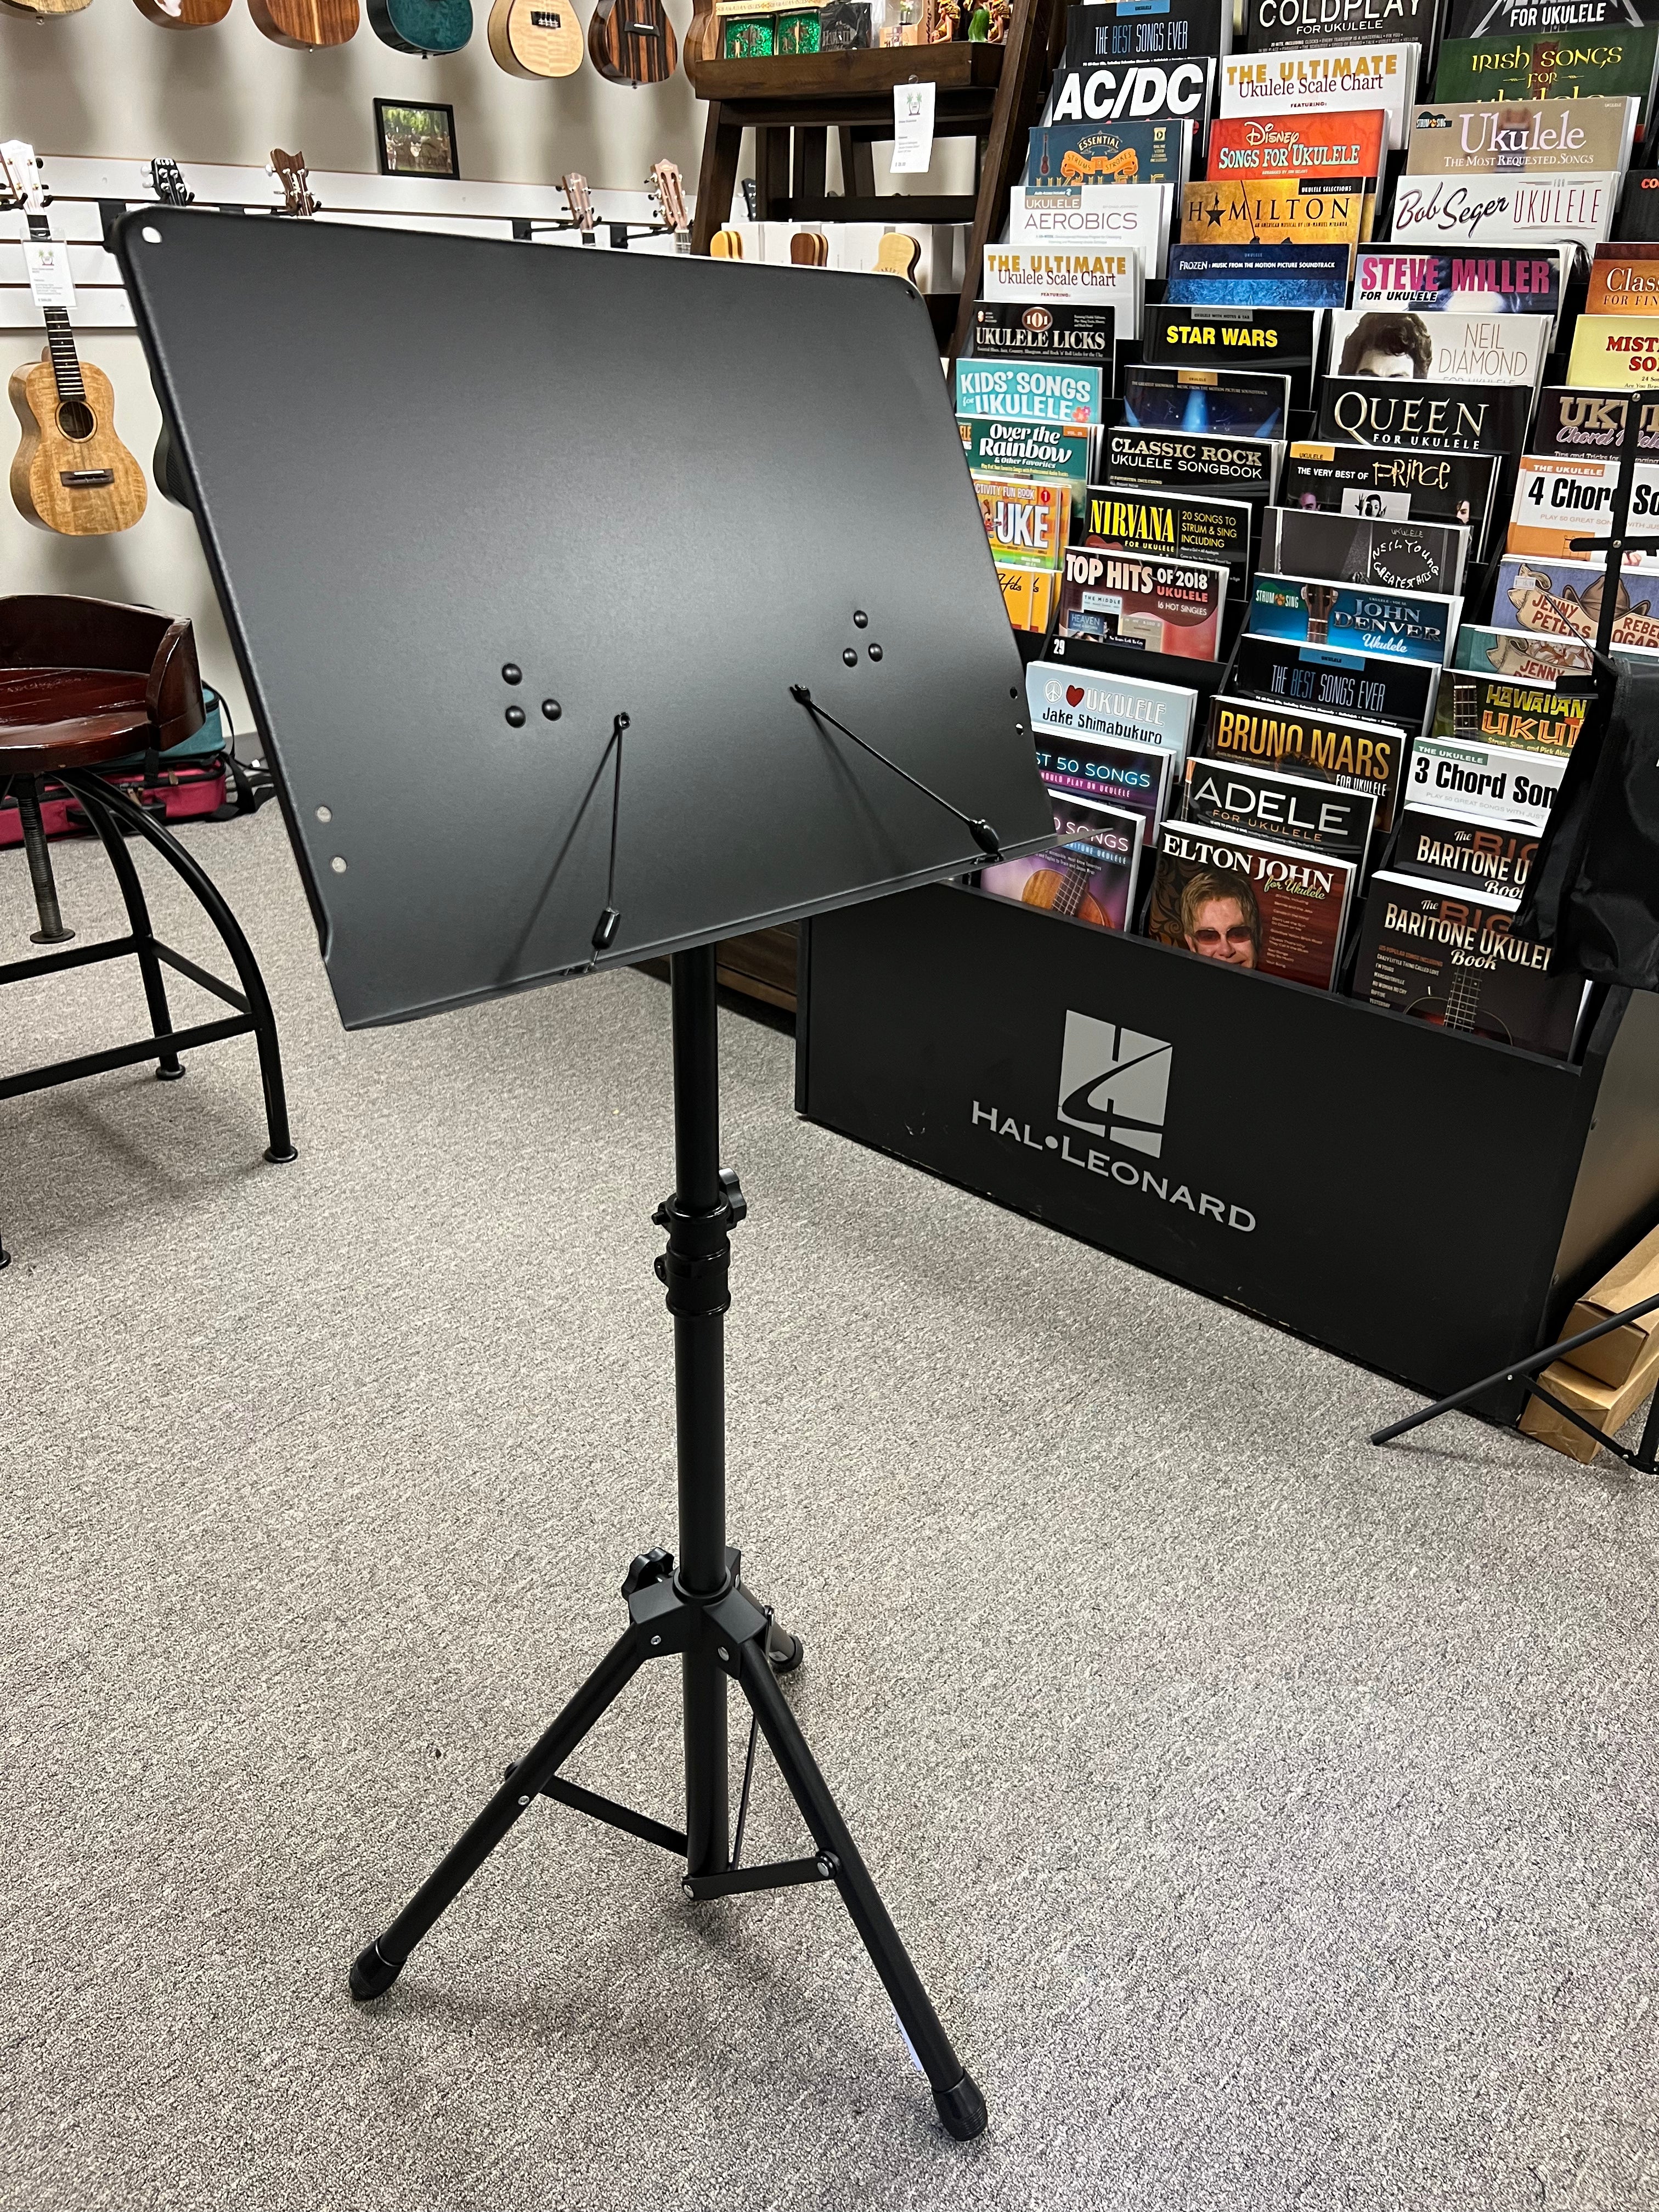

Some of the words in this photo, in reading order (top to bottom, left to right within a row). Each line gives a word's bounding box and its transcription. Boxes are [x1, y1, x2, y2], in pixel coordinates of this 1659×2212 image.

[1510, 8, 1537, 27] FOR
[1542, 2, 1606, 25] UKULELE
[1096, 26, 1108, 55] THE
[1113, 25, 1132, 54] BEST
[1136, 22, 1164, 52] SONGS
[1168, 21, 1188, 50] EVER
[1296, 25, 1321, 35] FOR
[1324, 20, 1383, 33] UKULELE
[1227, 65, 1267, 86] THE
[1279, 54, 1397, 80] ULTIMATE
[1052, 64, 1204, 121] AC/DC
[1238, 77, 1294, 98] Ukulele
[1298, 75, 1337, 94] Scale
[1341, 72, 1384, 91] Chart
[1079, 136, 1119, 151] ESSENTIAL
[1244, 121, 1300, 151] Disney
[1459, 110, 1587, 154] Ukulele
[1067, 154, 1091, 171] STRUMS
[1105, 152, 1132, 171] STROKES
[1218, 147, 1260, 169] SONGS
[1262, 148, 1289, 168] FOR
[1292, 144, 1361, 166] UKULELE
[1443, 156, 1464, 167] THE
[1466, 156, 1496, 167] MOST
[1497, 155, 1556, 167] REQUESTED
[1557, 153, 1594, 165] SONGS
[1026, 199, 1080, 209] UKULELE
[1396, 181, 1443, 230] Bob
[1438, 187, 1509, 239] Seger
[1514, 189, 1602, 223] UKULELE
[1024, 212, 1138, 230] AEROBICS
[988, 255, 1020, 272] THE
[1031, 256, 1126, 274] ULTIMATE
[1180, 261, 1207, 270] FROZEN
[1361, 257, 1439, 291] STEVE
[1452, 258, 1550, 294] MILLER
[998, 269, 1043, 284] Ukulele
[1046, 270, 1078, 286] Scale
[1081, 270, 1116, 286] Chart
[1359, 291, 1381, 301] FOR
[1386, 291, 1437, 302] UKULELE
[1604, 295, 1628, 305] FOR
[976, 327, 1048, 347] UKULELE
[1053, 330, 1105, 350] LICKS
[1166, 325, 1215, 345] STAR
[1222, 328, 1278, 348] WARS
[1464, 323, 1504, 349] NEIL
[1438, 349, 1527, 376] DIAMOND
[1016, 372, 1091, 402] SONGS
[975, 394, 1073, 421] UKULELE
[1334, 391, 1490, 445] QUEEN
[990, 424, 1030, 440] Over
[1033, 426, 1060, 444] the
[1373, 434, 1402, 444] FOR
[1411, 437, 1481, 450] UKULELE
[1556, 426, 1614, 445] Chord
[979, 438, 1072, 463] Rainbow
[1111, 437, 1196, 458] CLASSIC
[1201, 447, 1262, 466] ROCK
[1022, 459, 1056, 469] Favorites
[1111, 454, 1172, 470] UKULELE
[1178, 460, 1262, 479] SONGBOOK
[1297, 466, 1311, 475] THE
[1313, 467, 1333, 477] VERY
[1335, 470, 1356, 479] BEST
[1358, 472, 1369, 480] OF
[1534, 465, 1553, 473] THE
[1556, 466, 1603, 476] UKULELE
[1528, 476, 1545, 506] 4
[996, 501, 1049, 549] UKE
[1088, 499, 1175, 543] NIRVANA
[1182, 511, 1192, 520] 20
[1194, 512, 1223, 524] SONGS
[1225, 517, 1236, 526] TO
[1182, 523, 1206, 534] STRUM
[1209, 526, 1215, 535] &
[1143, 543, 1175, 552] UKULELE
[1181, 535, 1224, 548] INCLUDING
[1066, 554, 1103, 585] TOP
[1107, 561, 1153, 594] HITS
[1157, 568, 1173, 584] OF
[1175, 571, 1207, 589] 2018
[1157, 586, 1207, 602] UKULELE
[1256, 589, 1274, 604] STRUM
[1285, 595, 1299, 608] SING
[1071, 613, 1100, 625] HEAVEN
[1165, 603, 1178, 611] HOT
[1181, 605, 1207, 616] SINGLES
[1355, 599, 1421, 623] JOHN
[1334, 612, 1441, 642] DENVER
[1532, 611, 1591, 639] PETERS
[1054, 639, 1065, 654] 29
[1363, 633, 1407, 653] Ukulele
[1271, 665, 1288, 694] THE
[1290, 669, 1316, 699] BEST
[1318, 674, 1355, 706] SONGS
[1357, 680, 1386, 712] EVER
[1085, 687, 1166, 726] UKULELE
[1486, 684, 1587, 718] HAWAIIAN
[1042, 707, 1073, 725] Jake
[1078, 713, 1163, 745] Shimabukuro
[1217, 710, 1304, 757] BRUNO
[1310, 729, 1391, 781] MARS
[1418, 746, 1436, 755] THE
[1439, 749, 1484, 764] UKULELE
[1540, 745, 1554, 755] Pick
[1057, 758, 1079, 773] 50
[1085, 763, 1150, 787] SONGS
[1414, 757, 1430, 784] 3
[1435, 761, 1507, 799] Chord
[1066, 778, 1084, 788] PLAY
[1099, 785, 1130, 798] UKULELE
[1336, 774, 1351, 789] FOR
[1353, 777, 1386, 797] UKULELE
[1194, 777, 1351, 836] ADELE
[1454, 797, 1477, 806] GREAT
[1479, 802, 1505, 812] SONGS
[1506, 807, 1525, 816] WITH
[1526, 811, 1545, 820] JUST
[1212, 810, 1240, 823] FOR
[1248, 818, 1323, 842] UKULELE
[1454, 831, 1472, 842] The
[1163, 833, 1252, 875] ELTON
[1254, 857, 1334, 894] JOHN
[1416, 835, 1511, 882] BARITONE
[1263, 875, 1283, 893] for
[1285, 879, 1327, 900] Ukulele
[1421, 900, 1439, 910] The
[1384, 902, 1477, 950] BARITONE
[1451, 949, 1498, 970] Book
